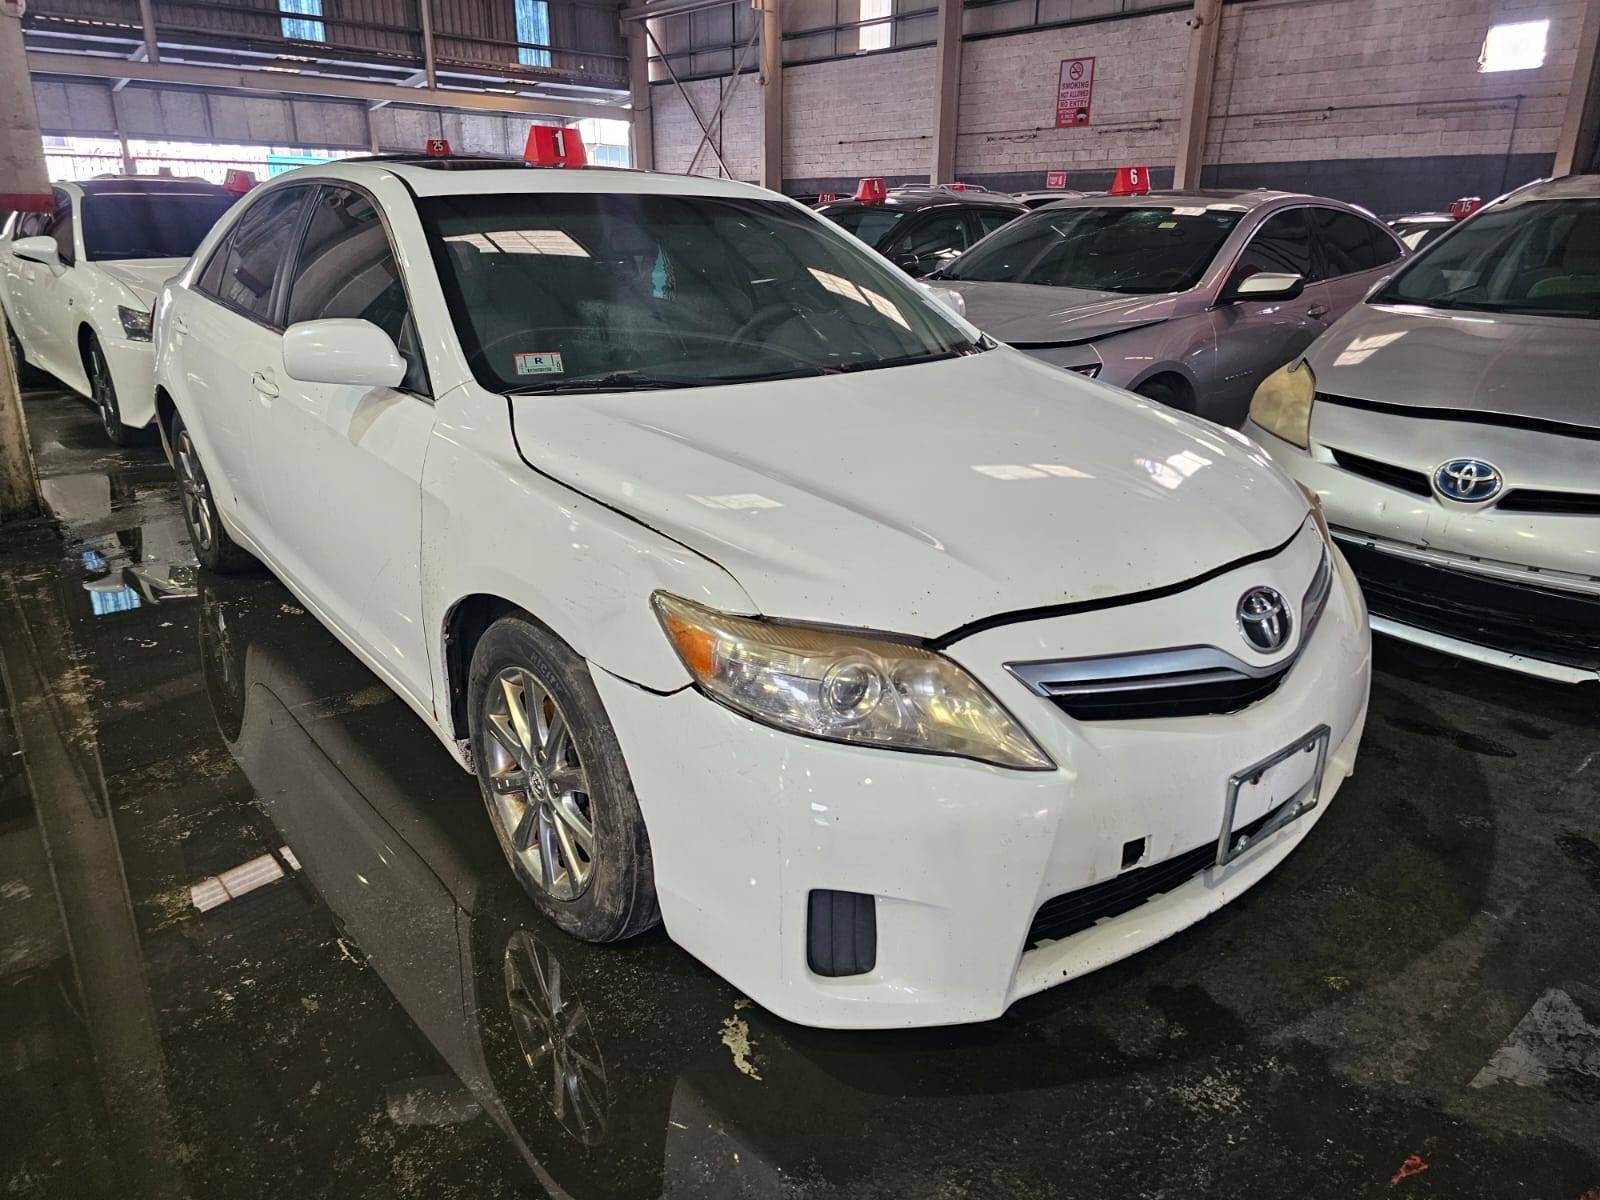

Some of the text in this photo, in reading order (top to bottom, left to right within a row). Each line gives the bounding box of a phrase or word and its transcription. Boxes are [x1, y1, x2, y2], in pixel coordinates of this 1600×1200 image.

[1062, 81, 1089, 90] SMOKING
[432, 141, 443, 152] 25
[554, 129, 565, 157] 1
[1130, 168, 1138, 185] 6
[873, 180, 880, 194] 4
[1461, 200, 1472, 213] 15
[534, 357, 543, 365] R
